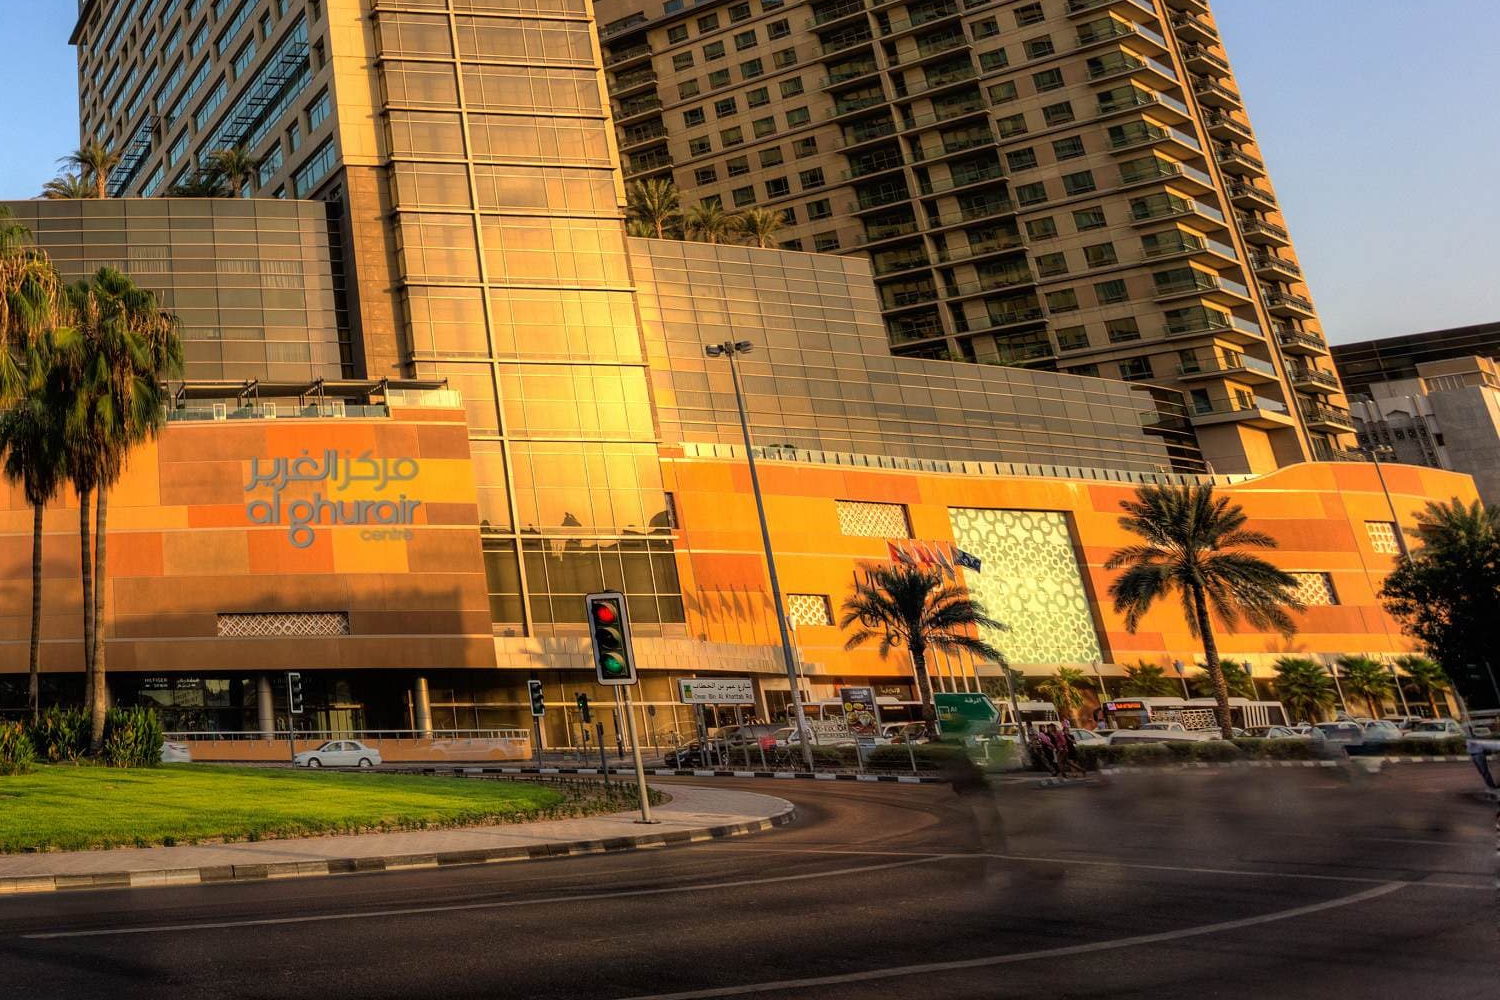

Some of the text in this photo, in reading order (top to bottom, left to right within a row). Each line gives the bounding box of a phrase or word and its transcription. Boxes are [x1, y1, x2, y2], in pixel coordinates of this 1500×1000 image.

[244, 448, 420, 492] مركز الغرير
[246, 491, 421, 549] al ghurair
[359, 528, 414, 543] centre
